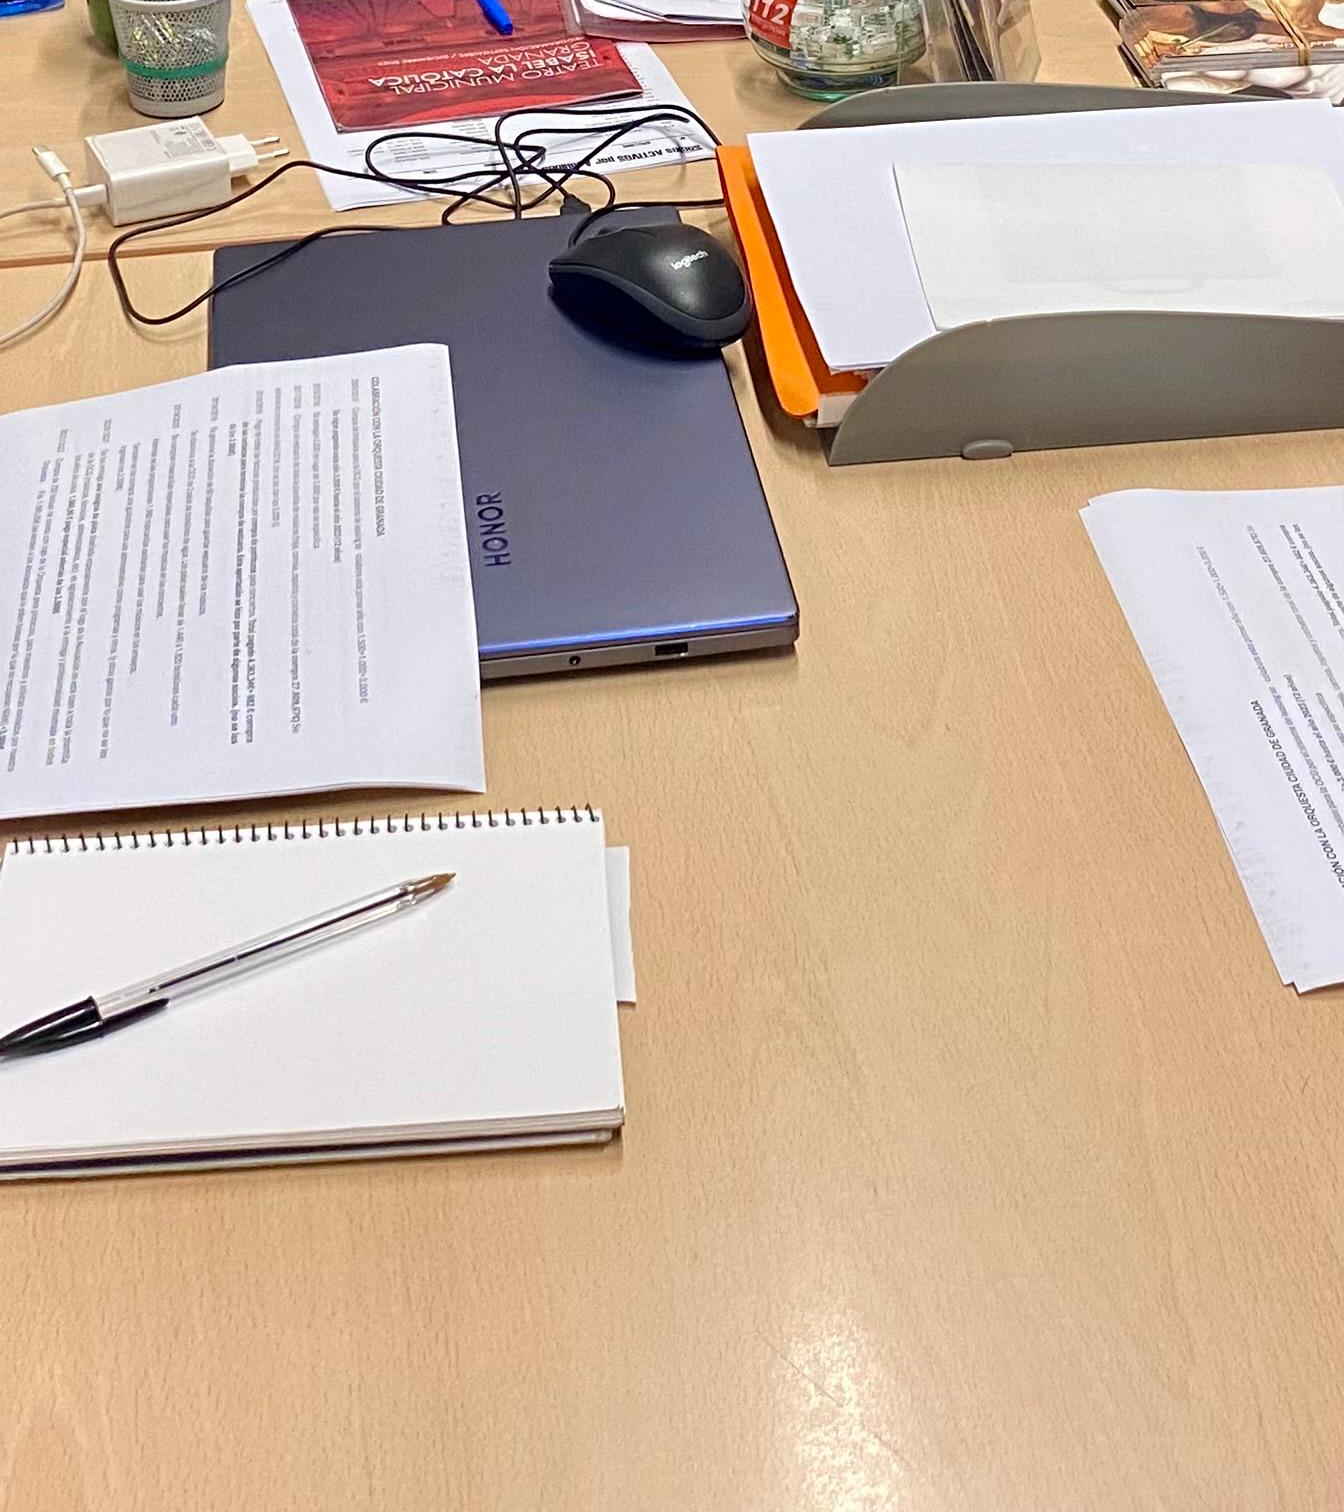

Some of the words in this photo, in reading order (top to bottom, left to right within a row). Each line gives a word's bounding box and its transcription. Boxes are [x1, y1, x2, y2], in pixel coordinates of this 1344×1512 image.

[476, 41, 592, 65] GRANADA
[520, 49, 597, 69] ISABEL
[367, 66, 484, 88] CATÓLICA
[487, 63, 517, 74] LA
[520, 57, 603, 79] TEATRO
[388, 71, 515, 96] MUNICIPAL
[595, 155, 616, 165] por
[617, 149, 663, 162] ACTIVOS
[670, 250, 708, 270] logitech
[477, 492, 511, 566] HONOR
[1248, 699, 1277, 737] GRANADA
[1267, 738, 1283, 749] DE
[1273, 750, 1299, 781] CIUDAD
[1289, 783, 1321, 826] ORQUESTA
[1311, 827, 1327, 838] LA
[1317, 839, 1337, 858] CON
